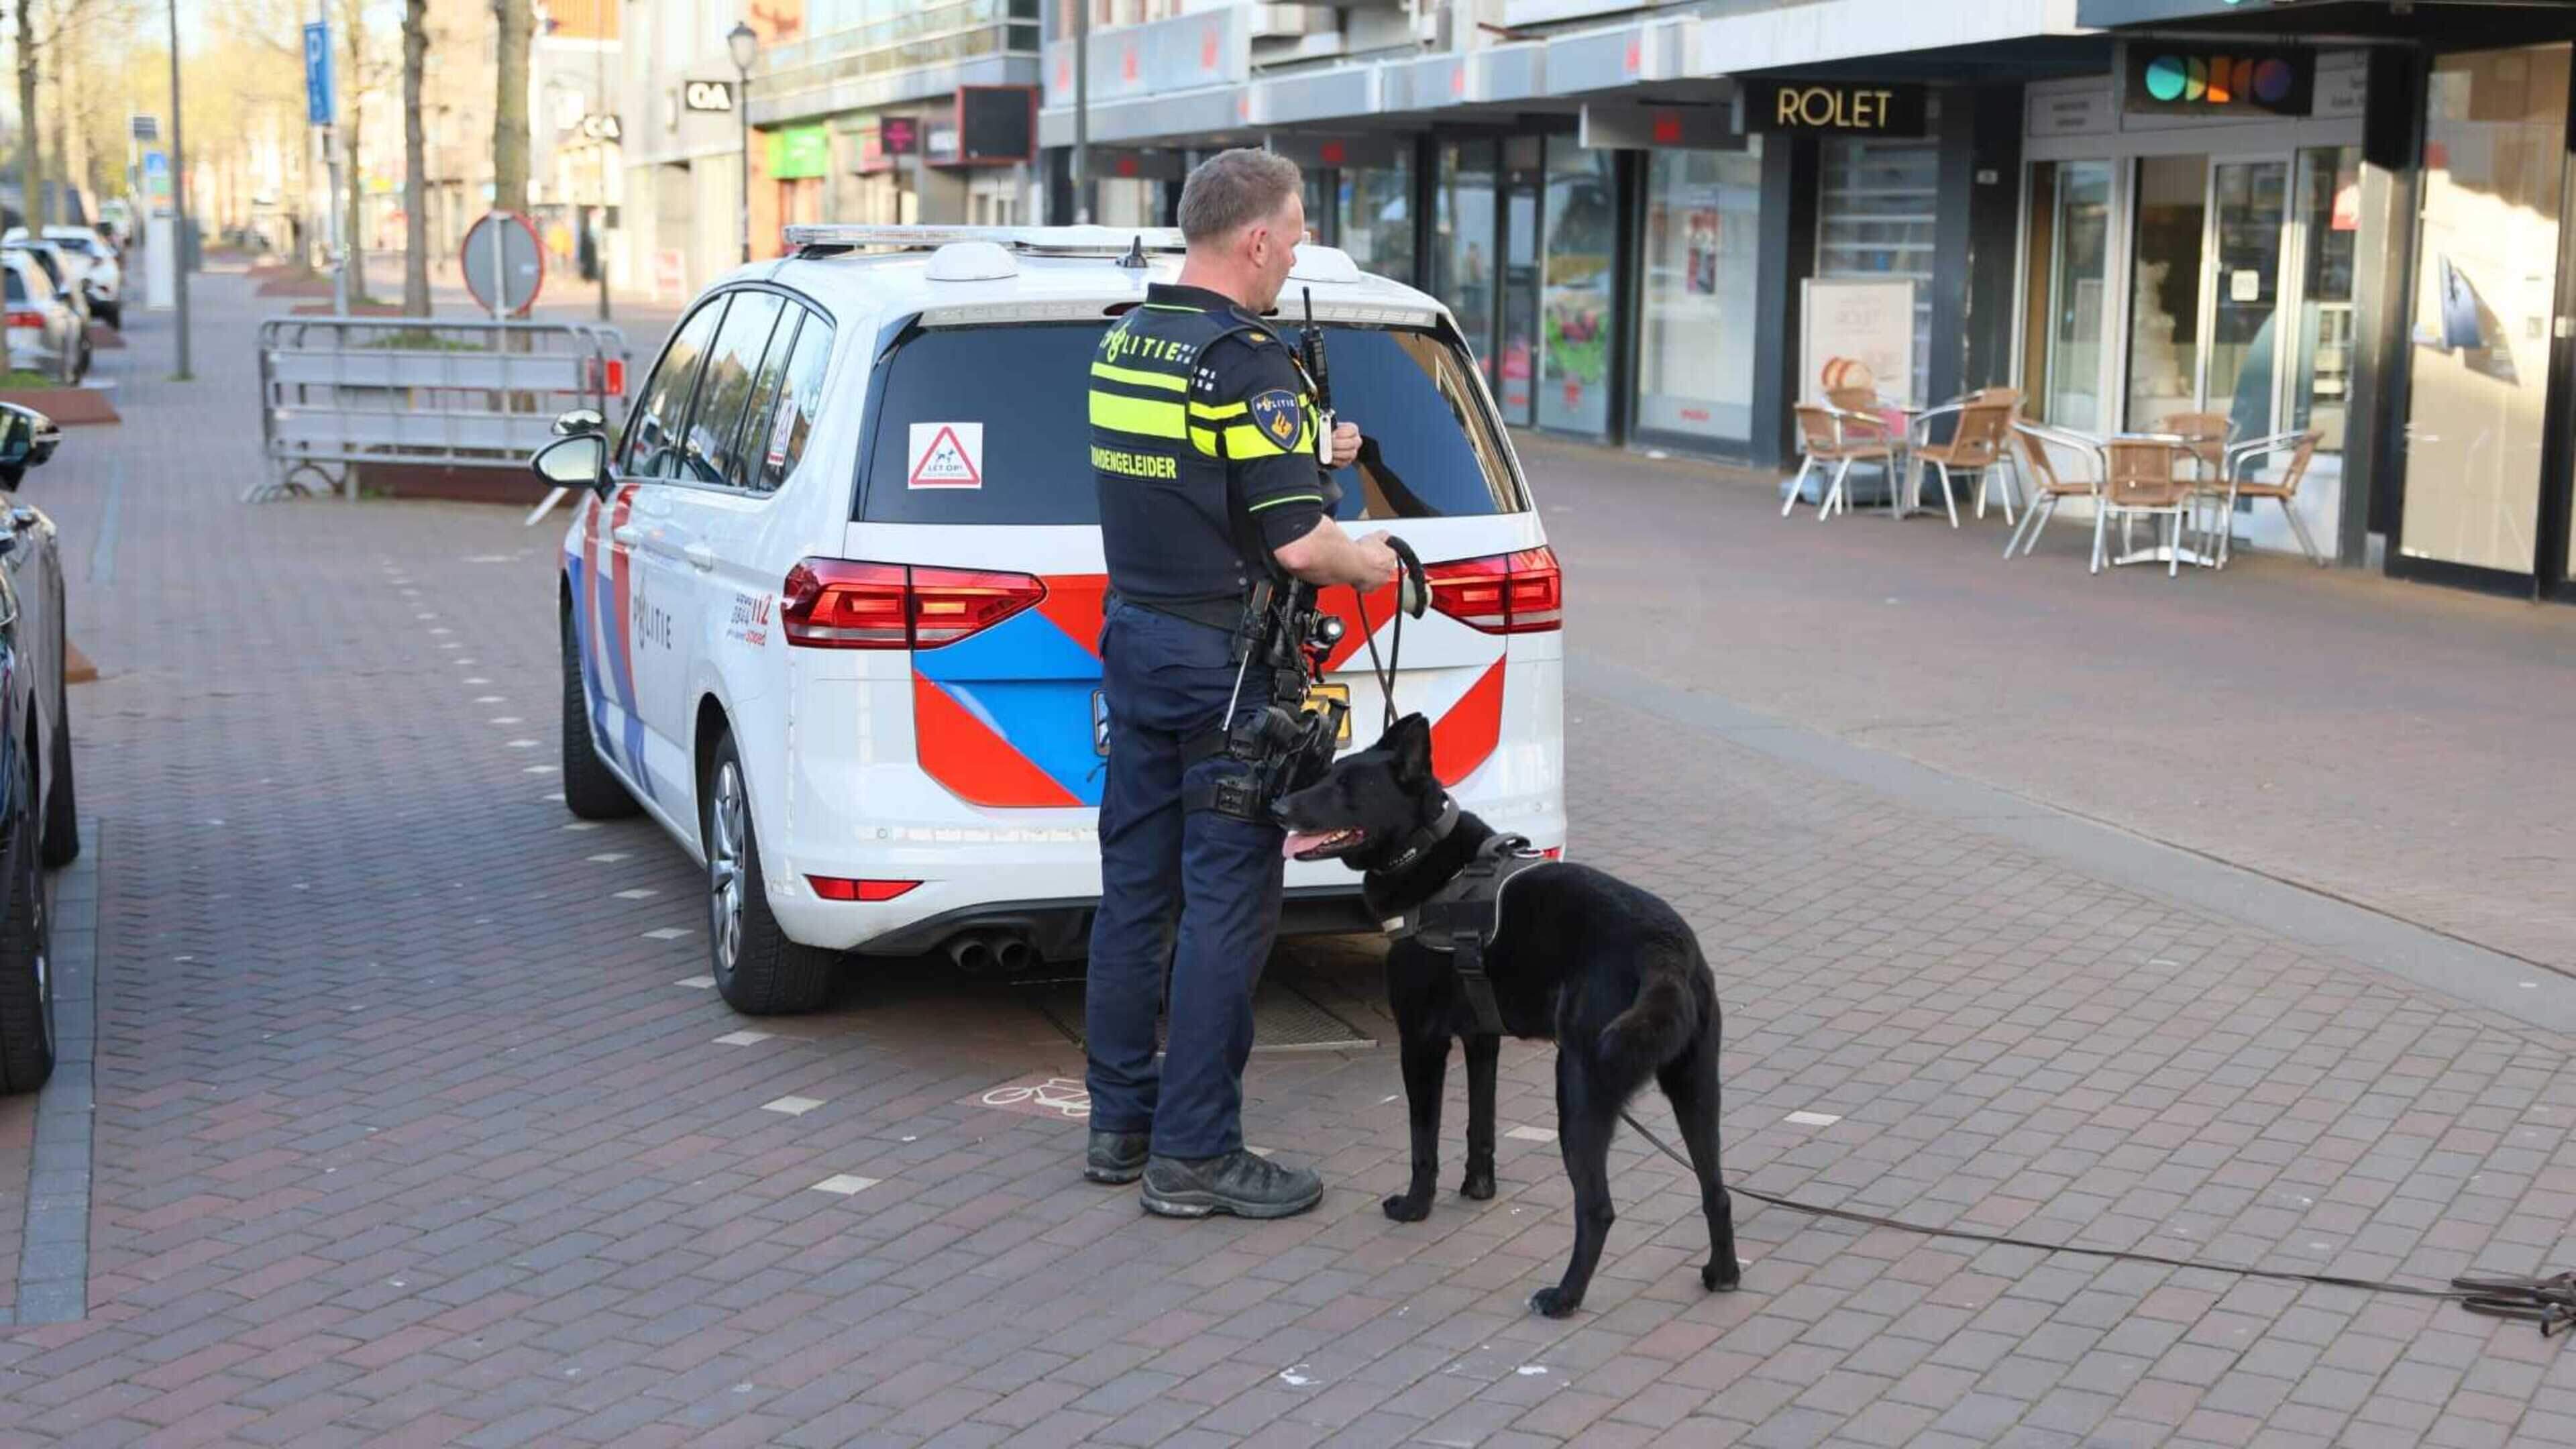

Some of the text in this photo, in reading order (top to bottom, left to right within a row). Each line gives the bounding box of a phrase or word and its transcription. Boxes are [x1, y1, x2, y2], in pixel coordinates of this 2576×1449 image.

[1778, 87, 1892, 127] ROLET
[1099, 319, 1181, 363] POLITIE
[1256, 396, 1295, 411] POLITIE
[633, 580, 672, 650] POLITIE
[751, 594, 772, 625] 112
